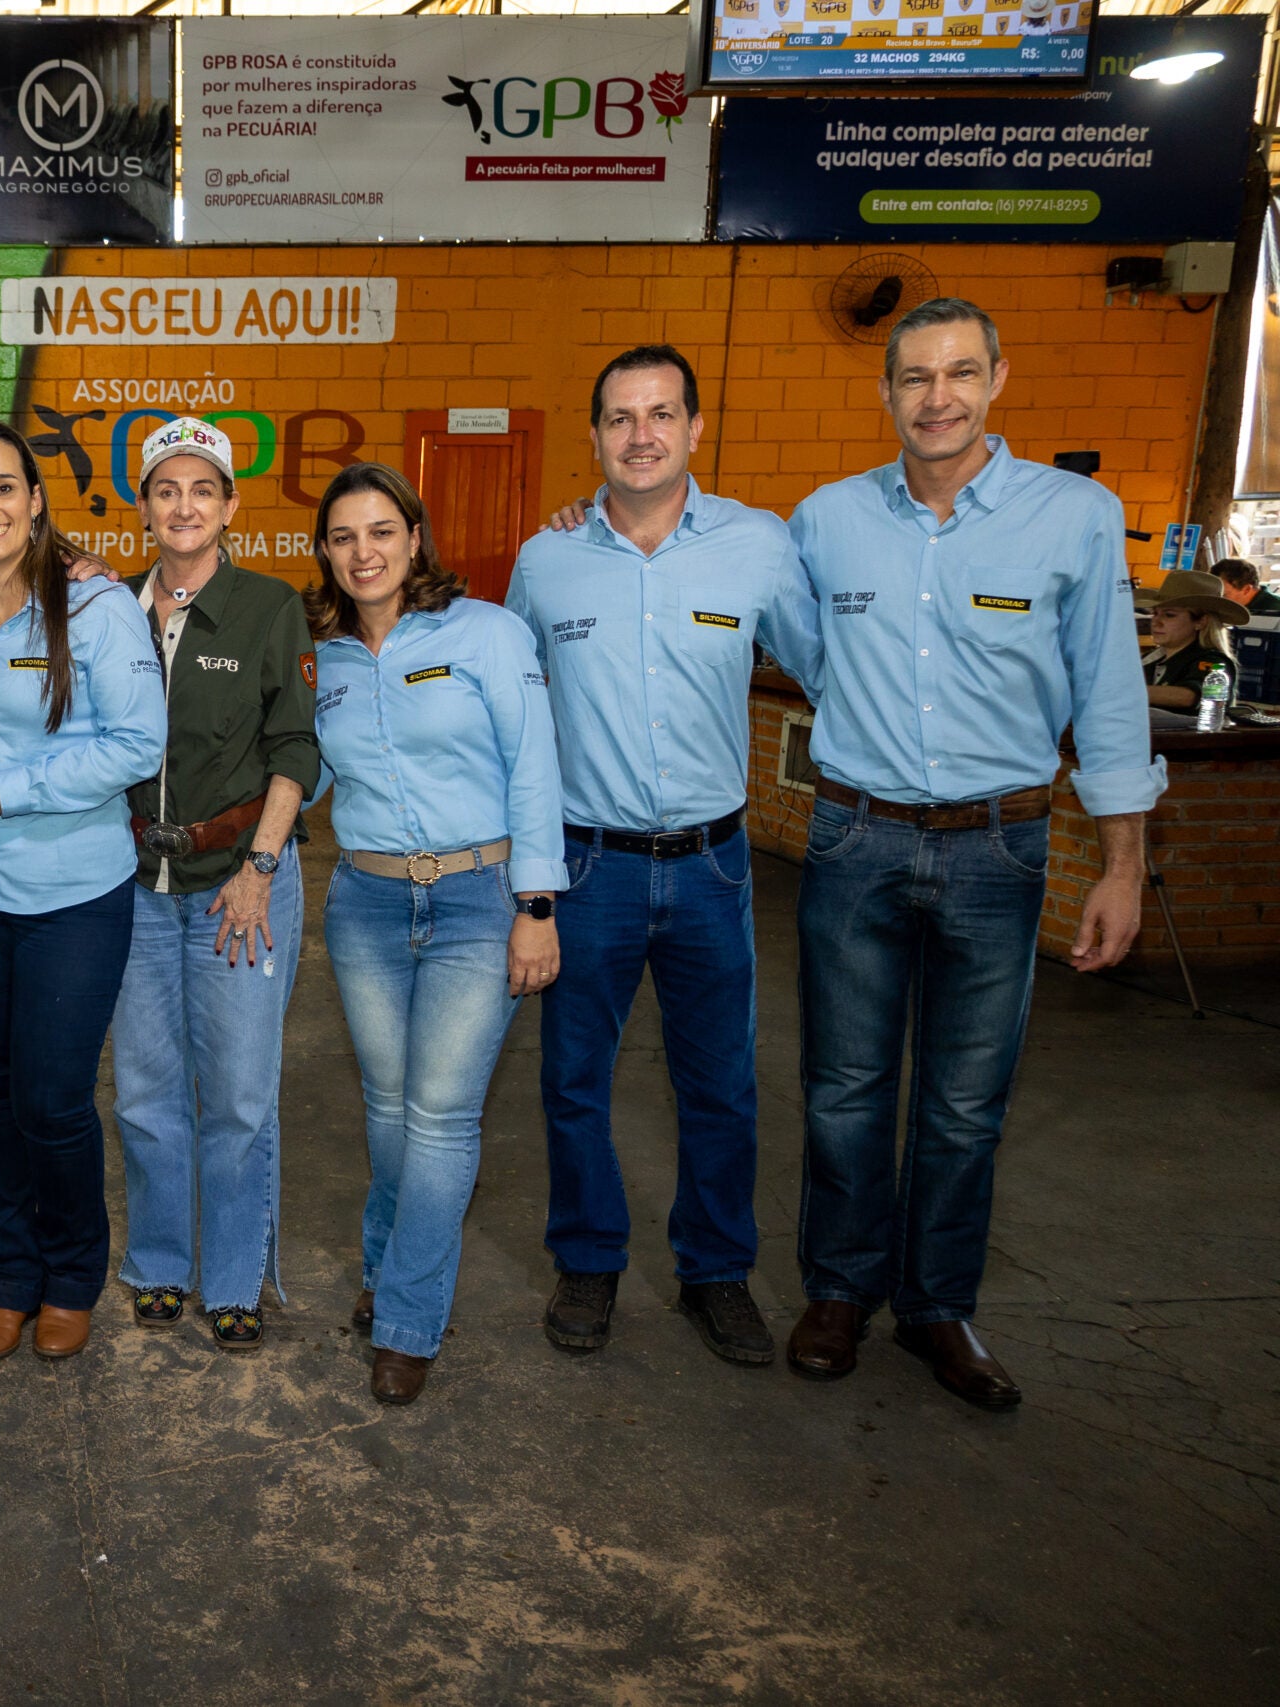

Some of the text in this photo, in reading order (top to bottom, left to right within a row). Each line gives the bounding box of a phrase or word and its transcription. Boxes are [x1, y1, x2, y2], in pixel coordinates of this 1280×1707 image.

[789, 36, 833, 45] LOTE: 20
[202, 53, 397, 70] GPB ROSA é constituída
[854, 53, 966, 63] 32 MACHOS 294KG
[202, 76, 417, 96] por mulheres inspiradoras
[202, 99, 383, 118] que fazem a diferença
[493, 77, 645, 139] GPB
[202, 119, 317, 137] na PECUÁRIA!
[825, 122, 1149, 145] Linha completa para atender
[816, 148, 1154, 171] qualquer desafio da pecuária!
[226, 169, 290, 186] gpb_oficial
[475, 163, 656, 178] A pecuária feita por mulheres!
[204, 192, 384, 207] GRUPOPECUARIABRASIL.COM.BR
[872, 198, 1088, 215] Entre em contato: (16) 99741-8295
[33, 285, 361, 342] NASCEU AQUI!
[73, 372, 235, 409] ASSOCIAÇÃO
[167, 428, 207, 445] GPB
[979, 597, 1025, 608] SILTOMAC
[699, 614, 737, 625] SILTOMAC
[207, 657, 239, 673] GPB
[409, 668, 447, 681] SILTOMAC
